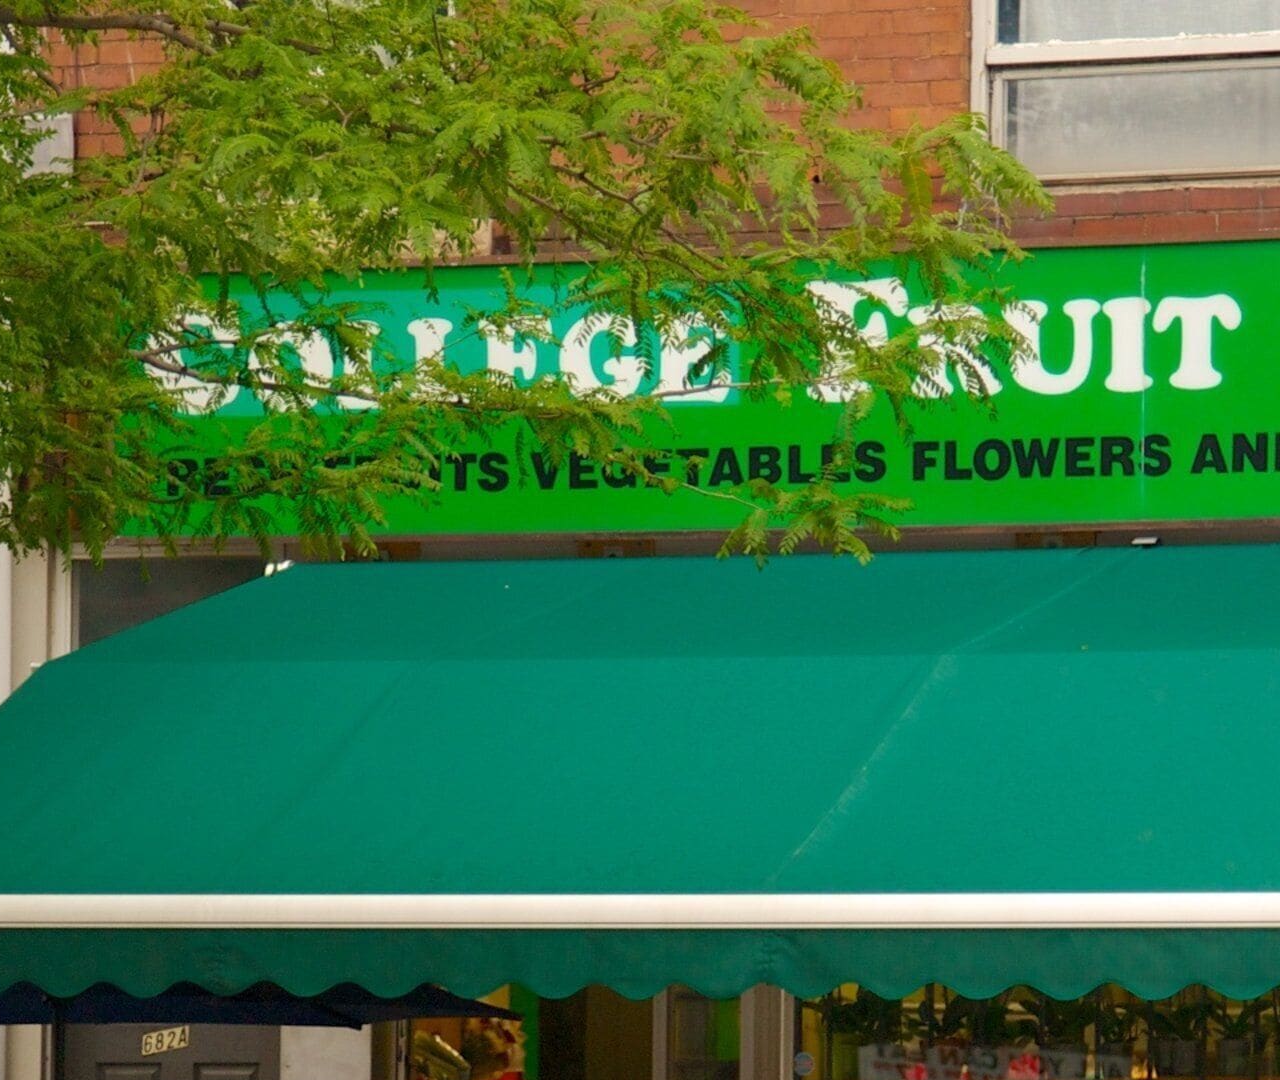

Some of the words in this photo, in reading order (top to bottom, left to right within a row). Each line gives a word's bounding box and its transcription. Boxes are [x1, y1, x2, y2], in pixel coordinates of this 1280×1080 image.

[806, 276, 1241, 404] FRUIT
[912, 434, 1171, 482] FLOWERS
[144, 1028, 187, 1054] 682A
